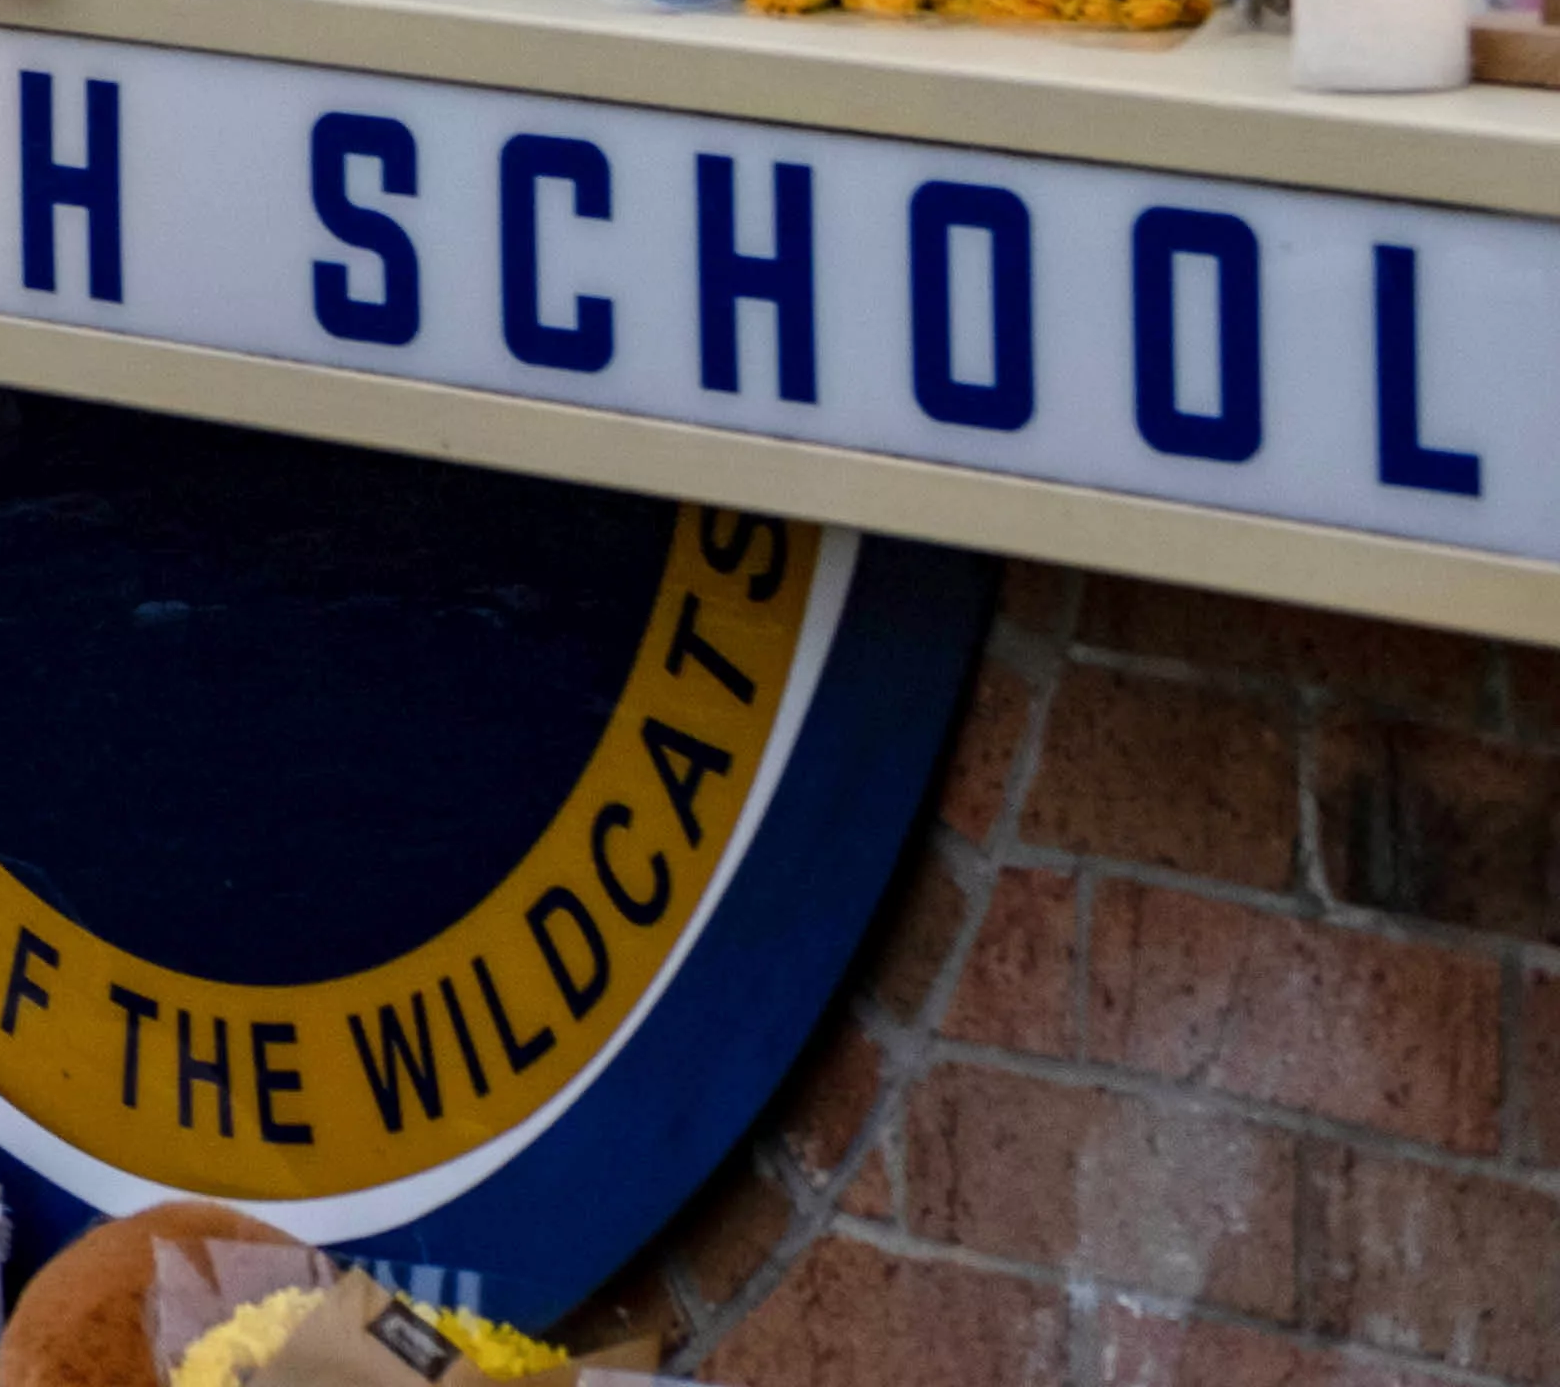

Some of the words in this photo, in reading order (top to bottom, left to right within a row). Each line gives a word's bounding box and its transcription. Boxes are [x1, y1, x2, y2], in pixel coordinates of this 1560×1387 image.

[309, 113, 1483, 497] SCHOOL
[108, 982, 315, 1146] THE
[348, 509, 791, 1134] WILDCATS
